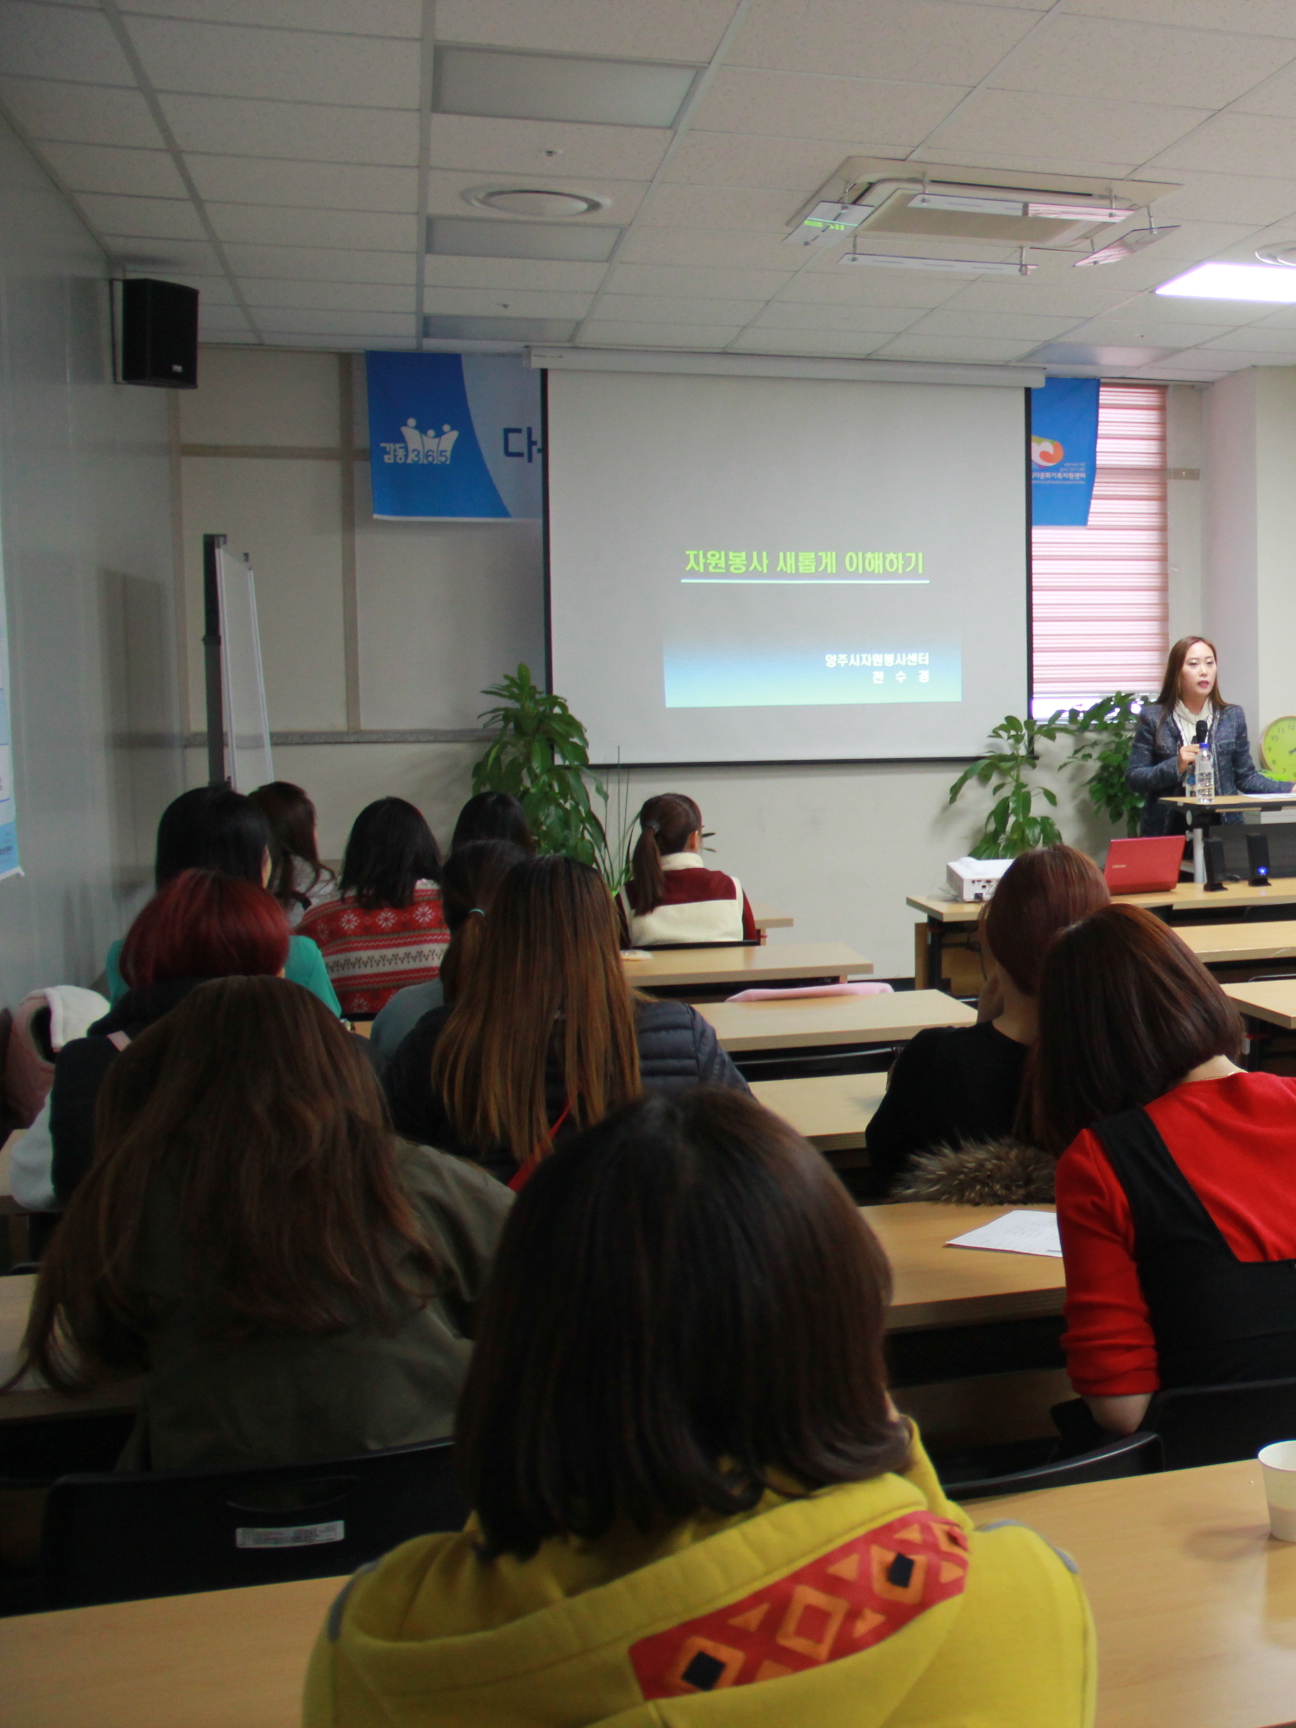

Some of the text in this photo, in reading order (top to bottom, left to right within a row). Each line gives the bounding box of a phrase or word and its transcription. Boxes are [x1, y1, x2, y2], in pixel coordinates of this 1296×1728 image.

[685, 549, 924, 575] 자원봉사 새롭게 이해하기
[824, 652, 930, 668] 양주시자원봉사센터
